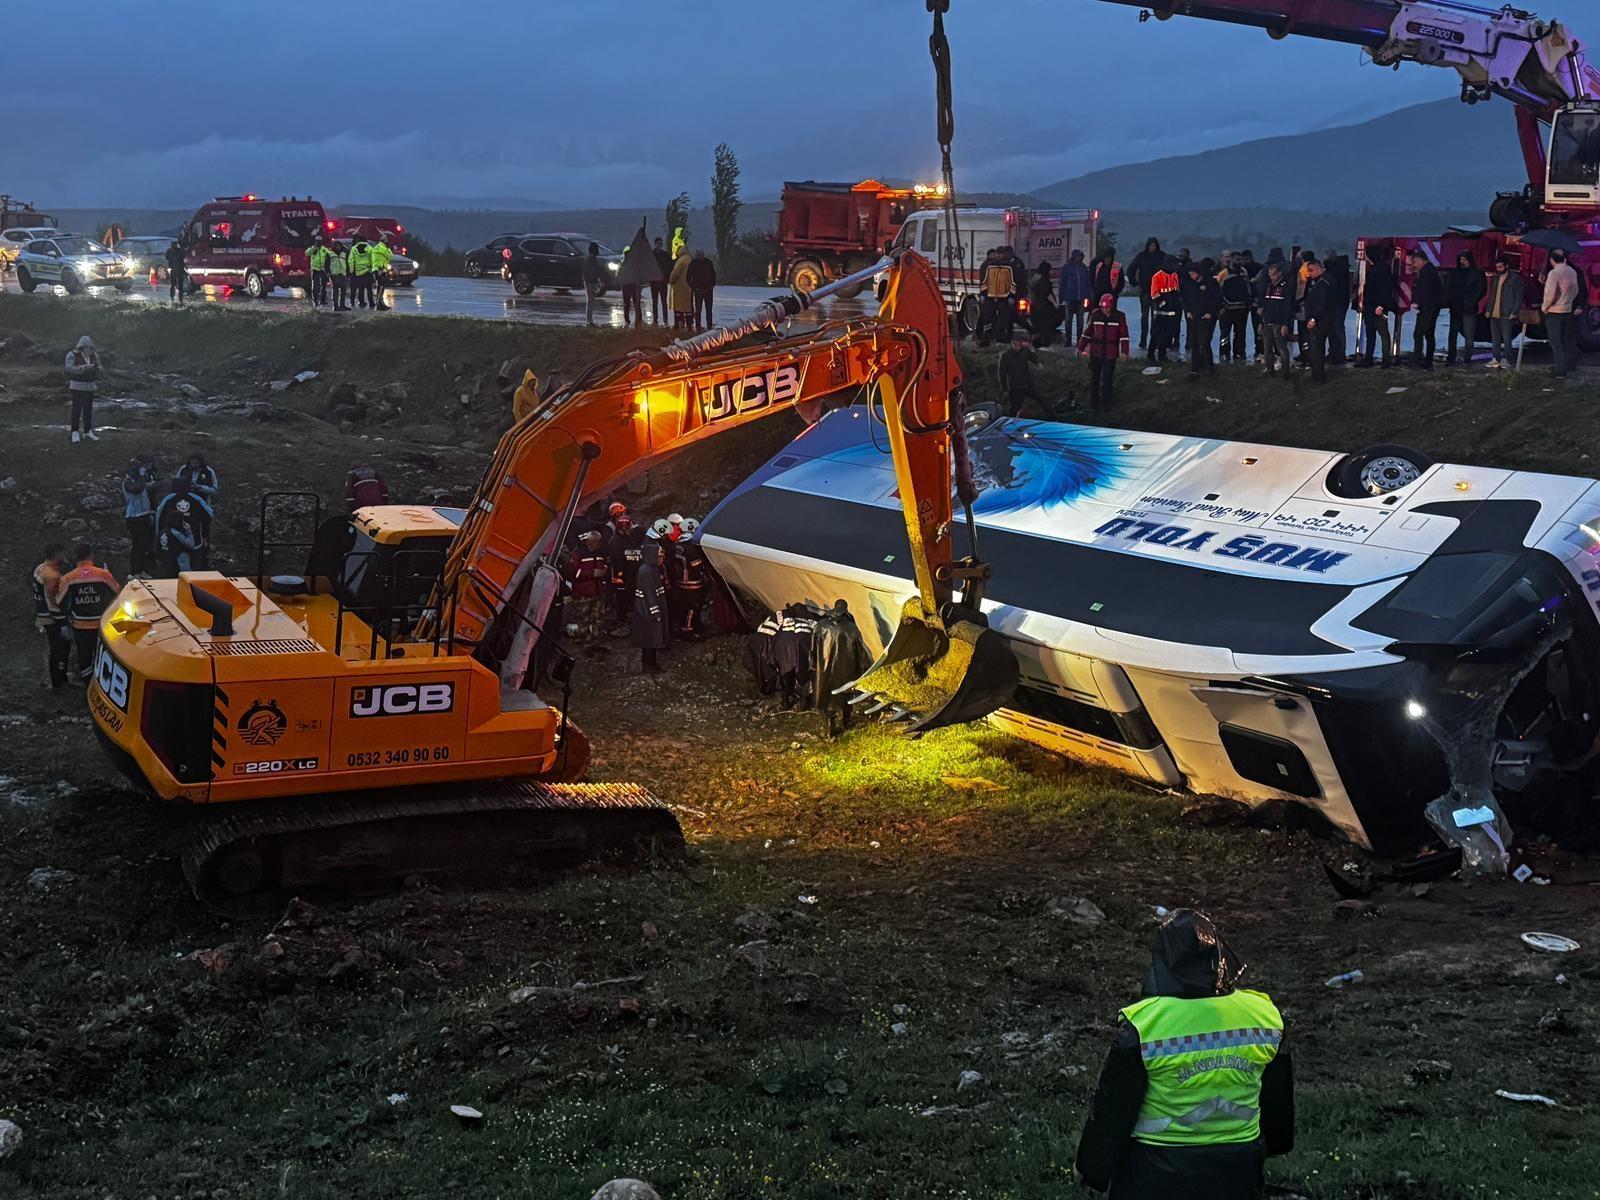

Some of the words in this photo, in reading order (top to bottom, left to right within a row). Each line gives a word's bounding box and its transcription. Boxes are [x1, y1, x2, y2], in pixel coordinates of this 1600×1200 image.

[1038, 238, 1063, 248] AFAD
[703, 366, 799, 419] JCB
[1273, 513, 1297, 522] 49
[1302, 517, 1330, 527] 00
[1331, 522, 1370, 534] 444
[1092, 517, 1219, 552] YOLU
[1212, 534, 1352, 574] MUŞ
[94, 637, 129, 708] JCB
[353, 684, 452, 716] JCB
[347, 751, 381, 767] 0532
[385, 749, 409, 764] 340
[413, 747, 430, 762] 90
[433, 746, 450, 761] 60
